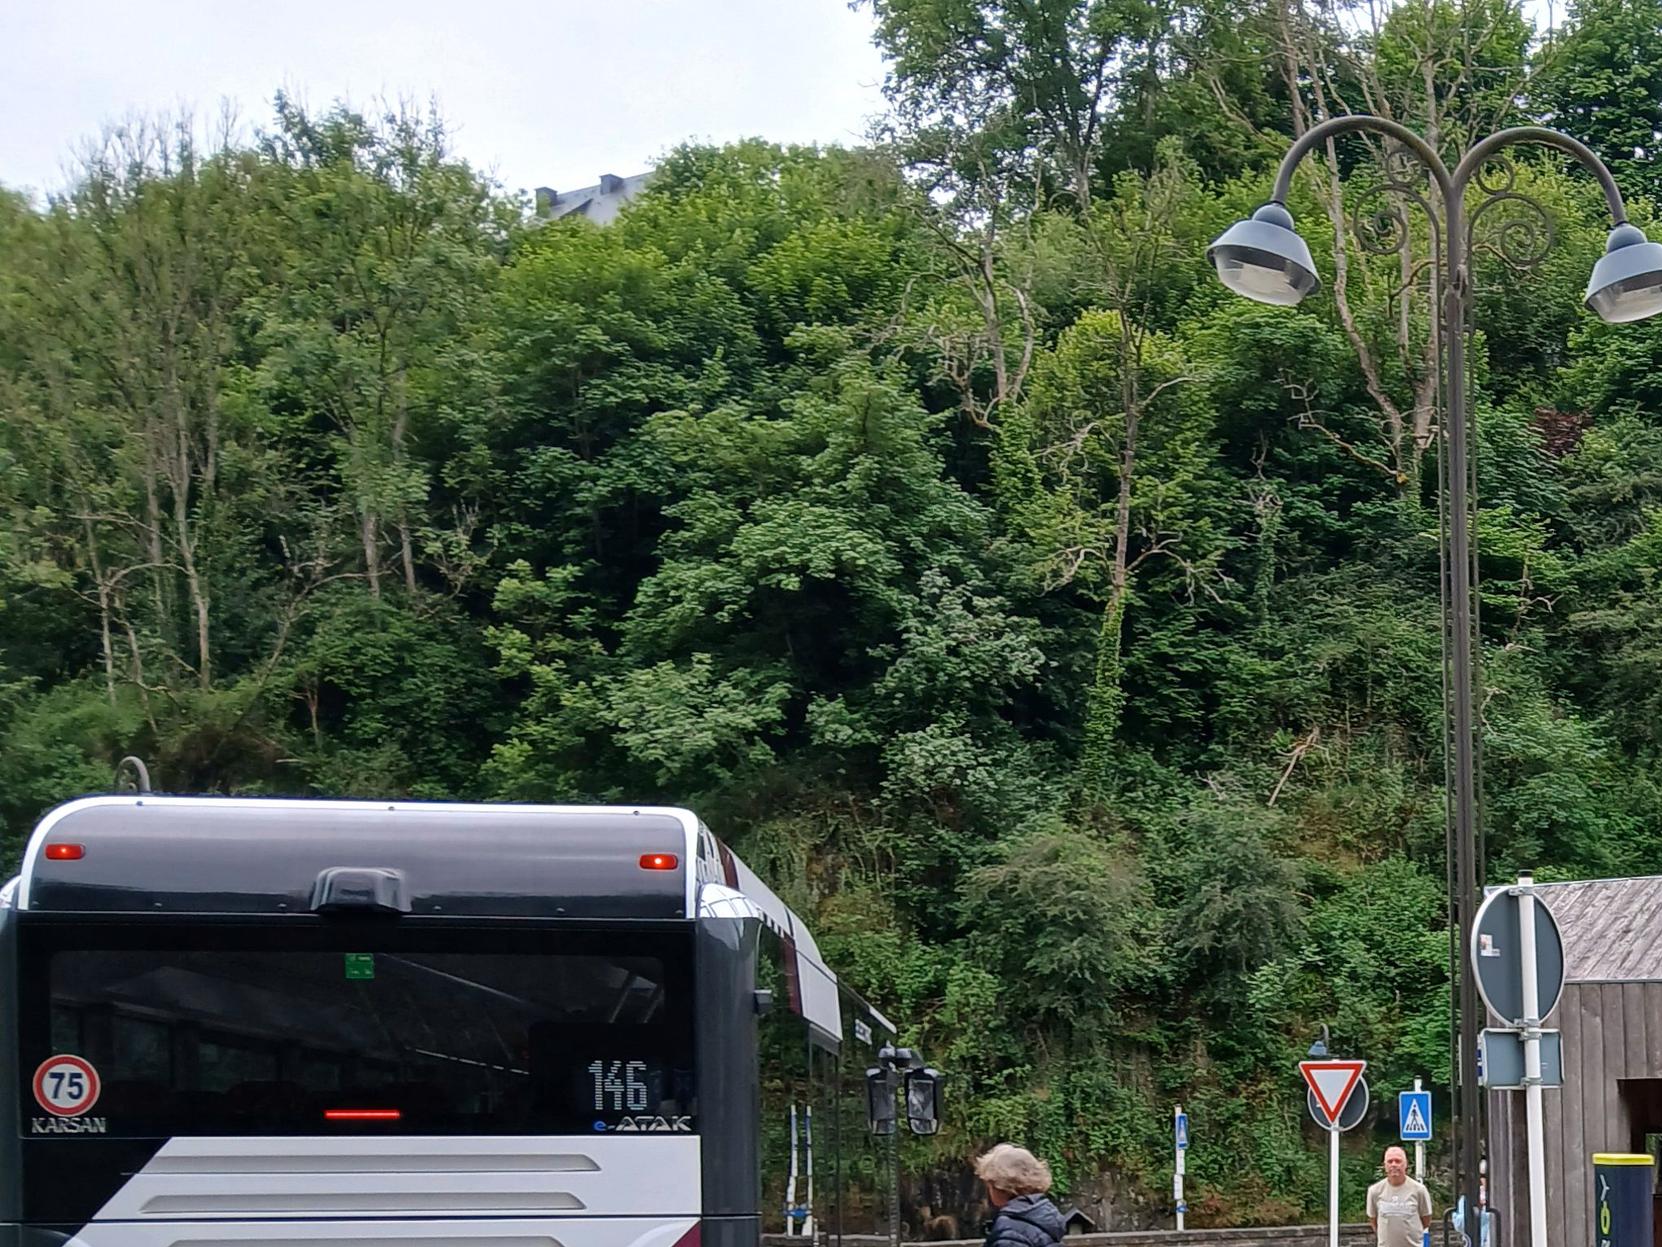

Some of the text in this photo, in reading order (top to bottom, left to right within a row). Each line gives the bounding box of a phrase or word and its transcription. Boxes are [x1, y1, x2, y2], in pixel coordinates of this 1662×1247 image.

[48, 1072, 83, 1100] 75
[588, 1060, 647, 1110] 146
[32, 1117, 106, 1134] KARSAN
[594, 1115, 692, 1131] e-ATAK
